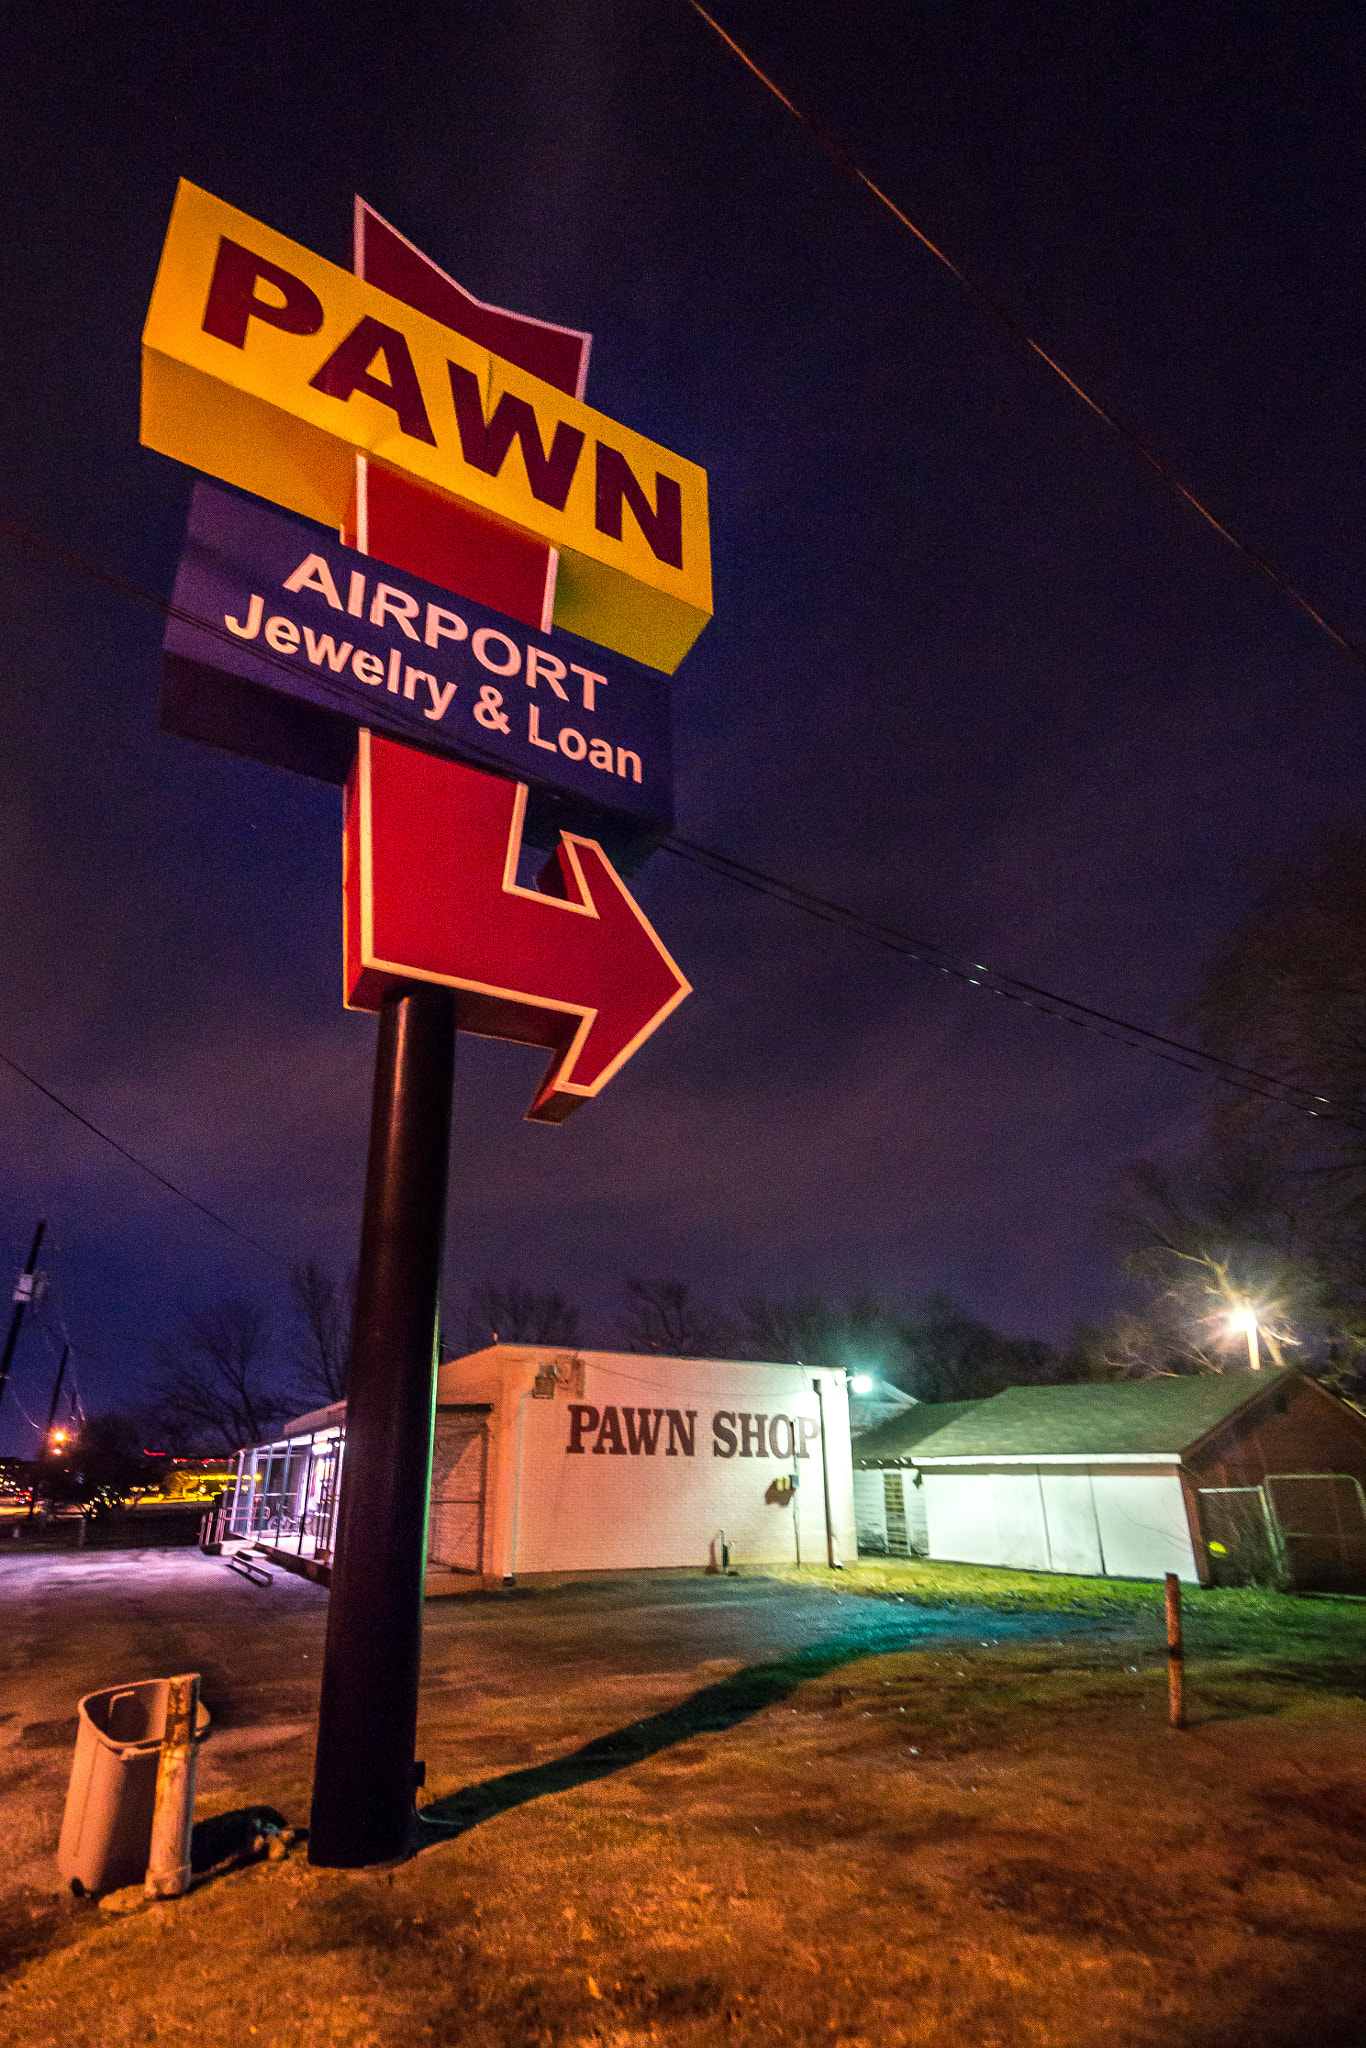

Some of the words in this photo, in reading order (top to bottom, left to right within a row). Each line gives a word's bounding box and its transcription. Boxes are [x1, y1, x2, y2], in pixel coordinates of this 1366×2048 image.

[201, 235, 684, 571] PAWN
[224, 594, 457, 721] Jewelry
[472, 685, 511, 735] &
[528, 705, 643, 784] Loan
[282, 553, 608, 712] AIRPORT
[565, 1404, 697, 1456] PAWN
[712, 1410, 819, 1459] SHOP
